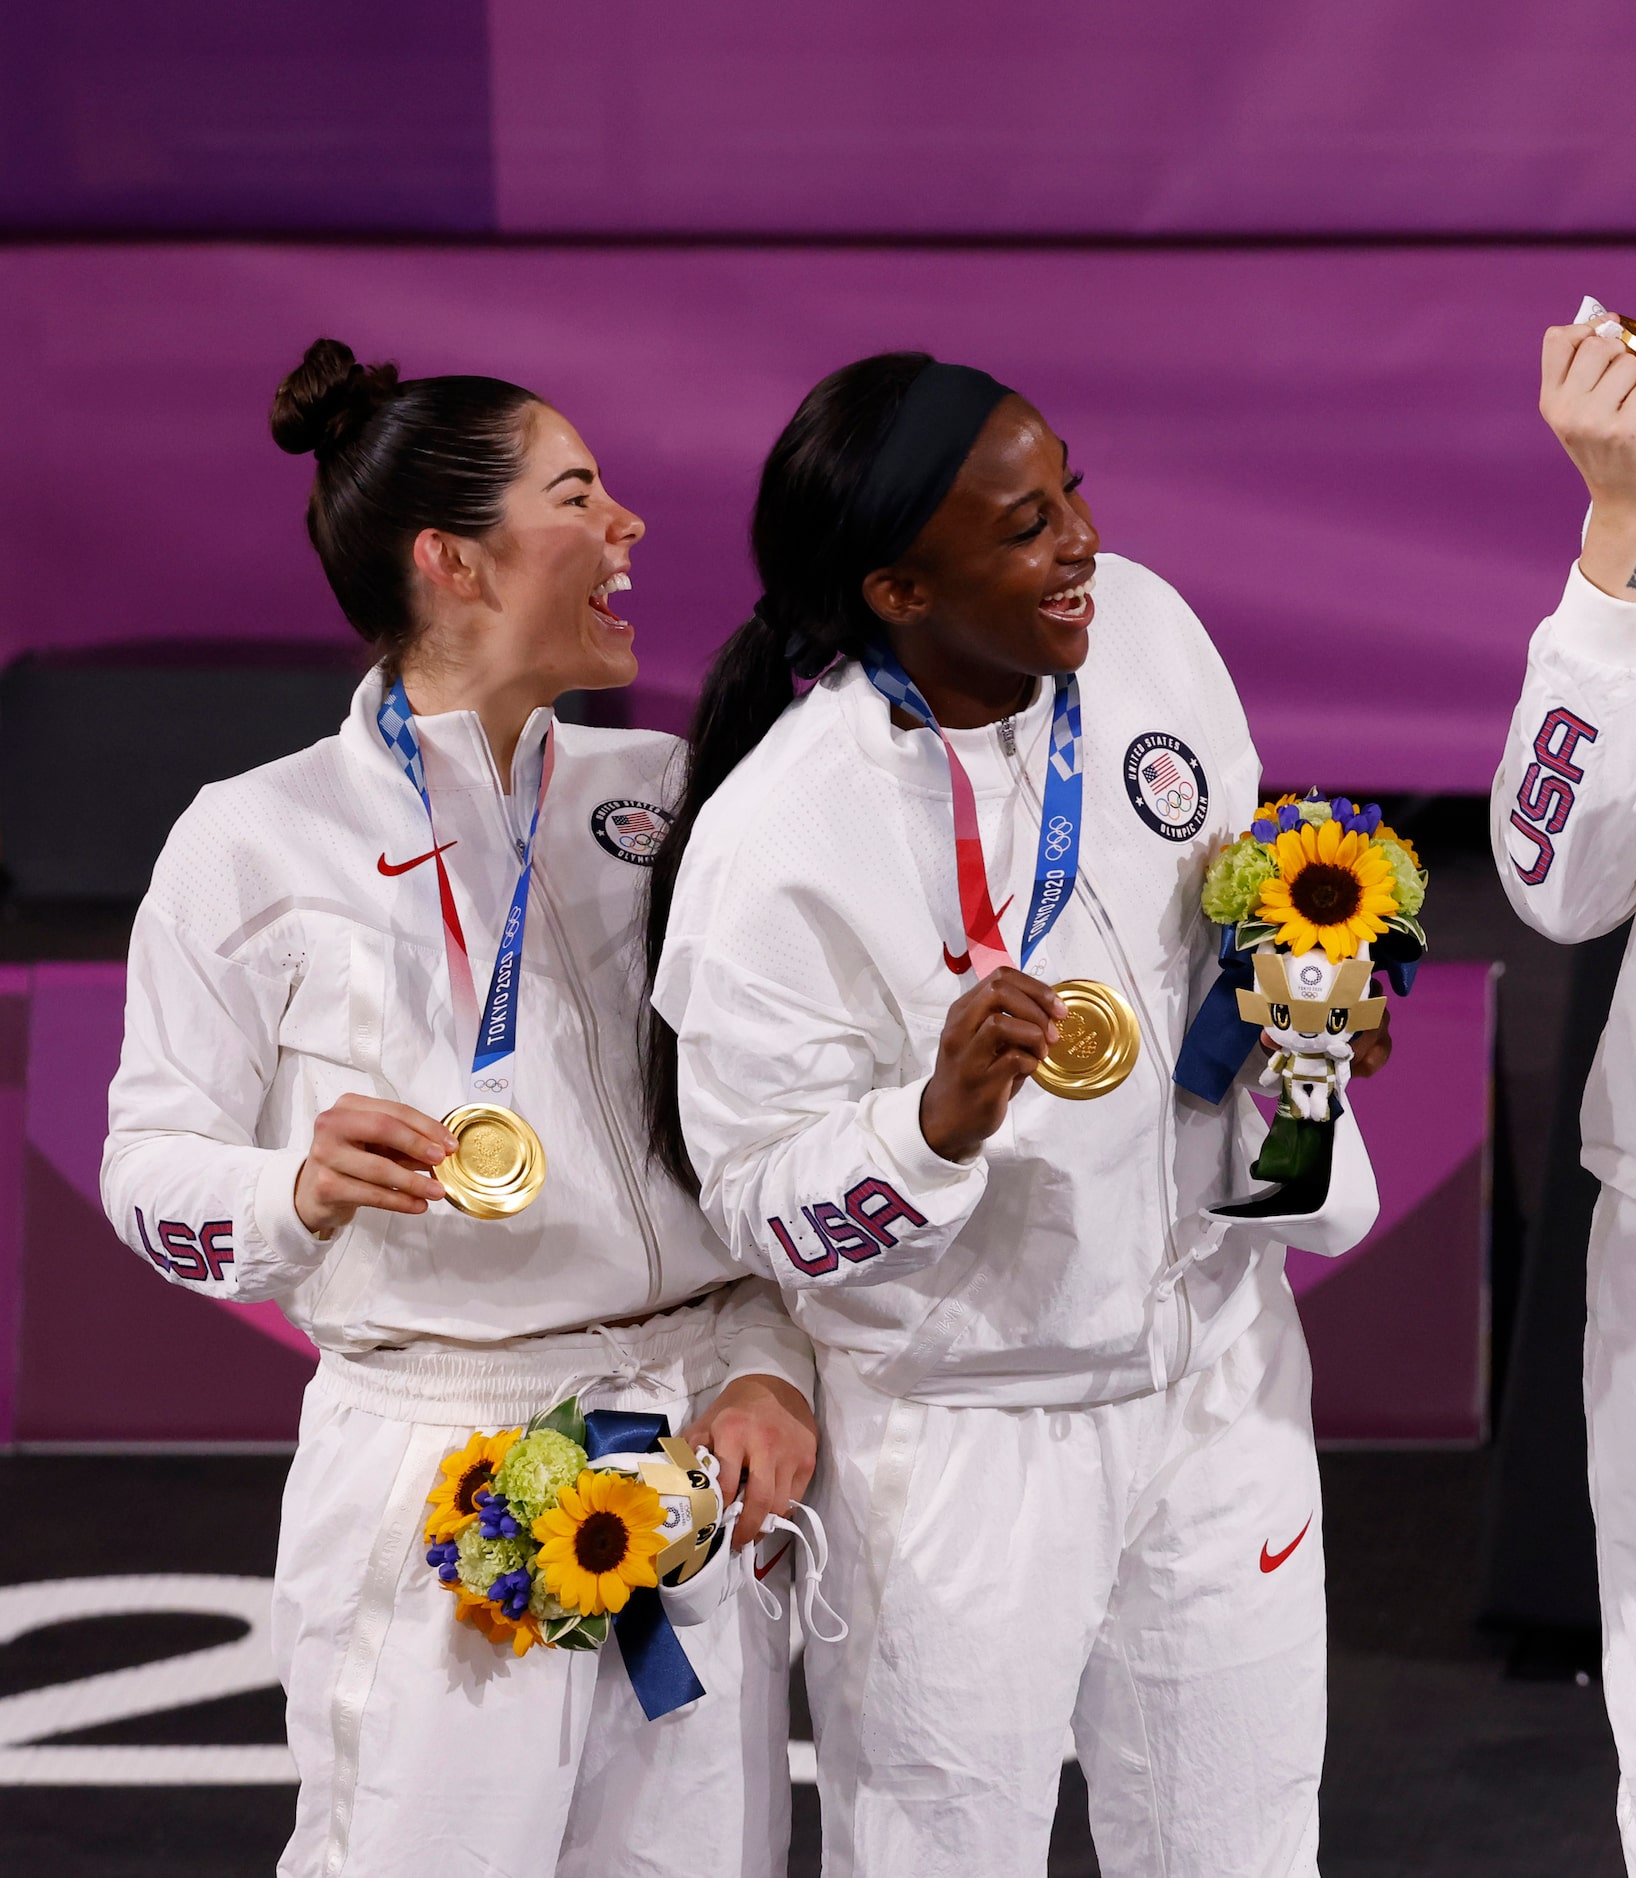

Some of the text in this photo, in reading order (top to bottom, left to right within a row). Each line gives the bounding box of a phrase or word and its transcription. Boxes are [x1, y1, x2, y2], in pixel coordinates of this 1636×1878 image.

[1128, 736, 1180, 780] UNITED STATES
[595, 801, 621, 820] UNITED
[1160, 796, 1208, 838] OLYMPIC TEAM
[1509, 706, 1599, 886] USA
[1028, 869, 1065, 942] TOKYO 2020
[487, 951, 513, 1046] TOKYO 2020
[767, 1176, 929, 1277] USA
